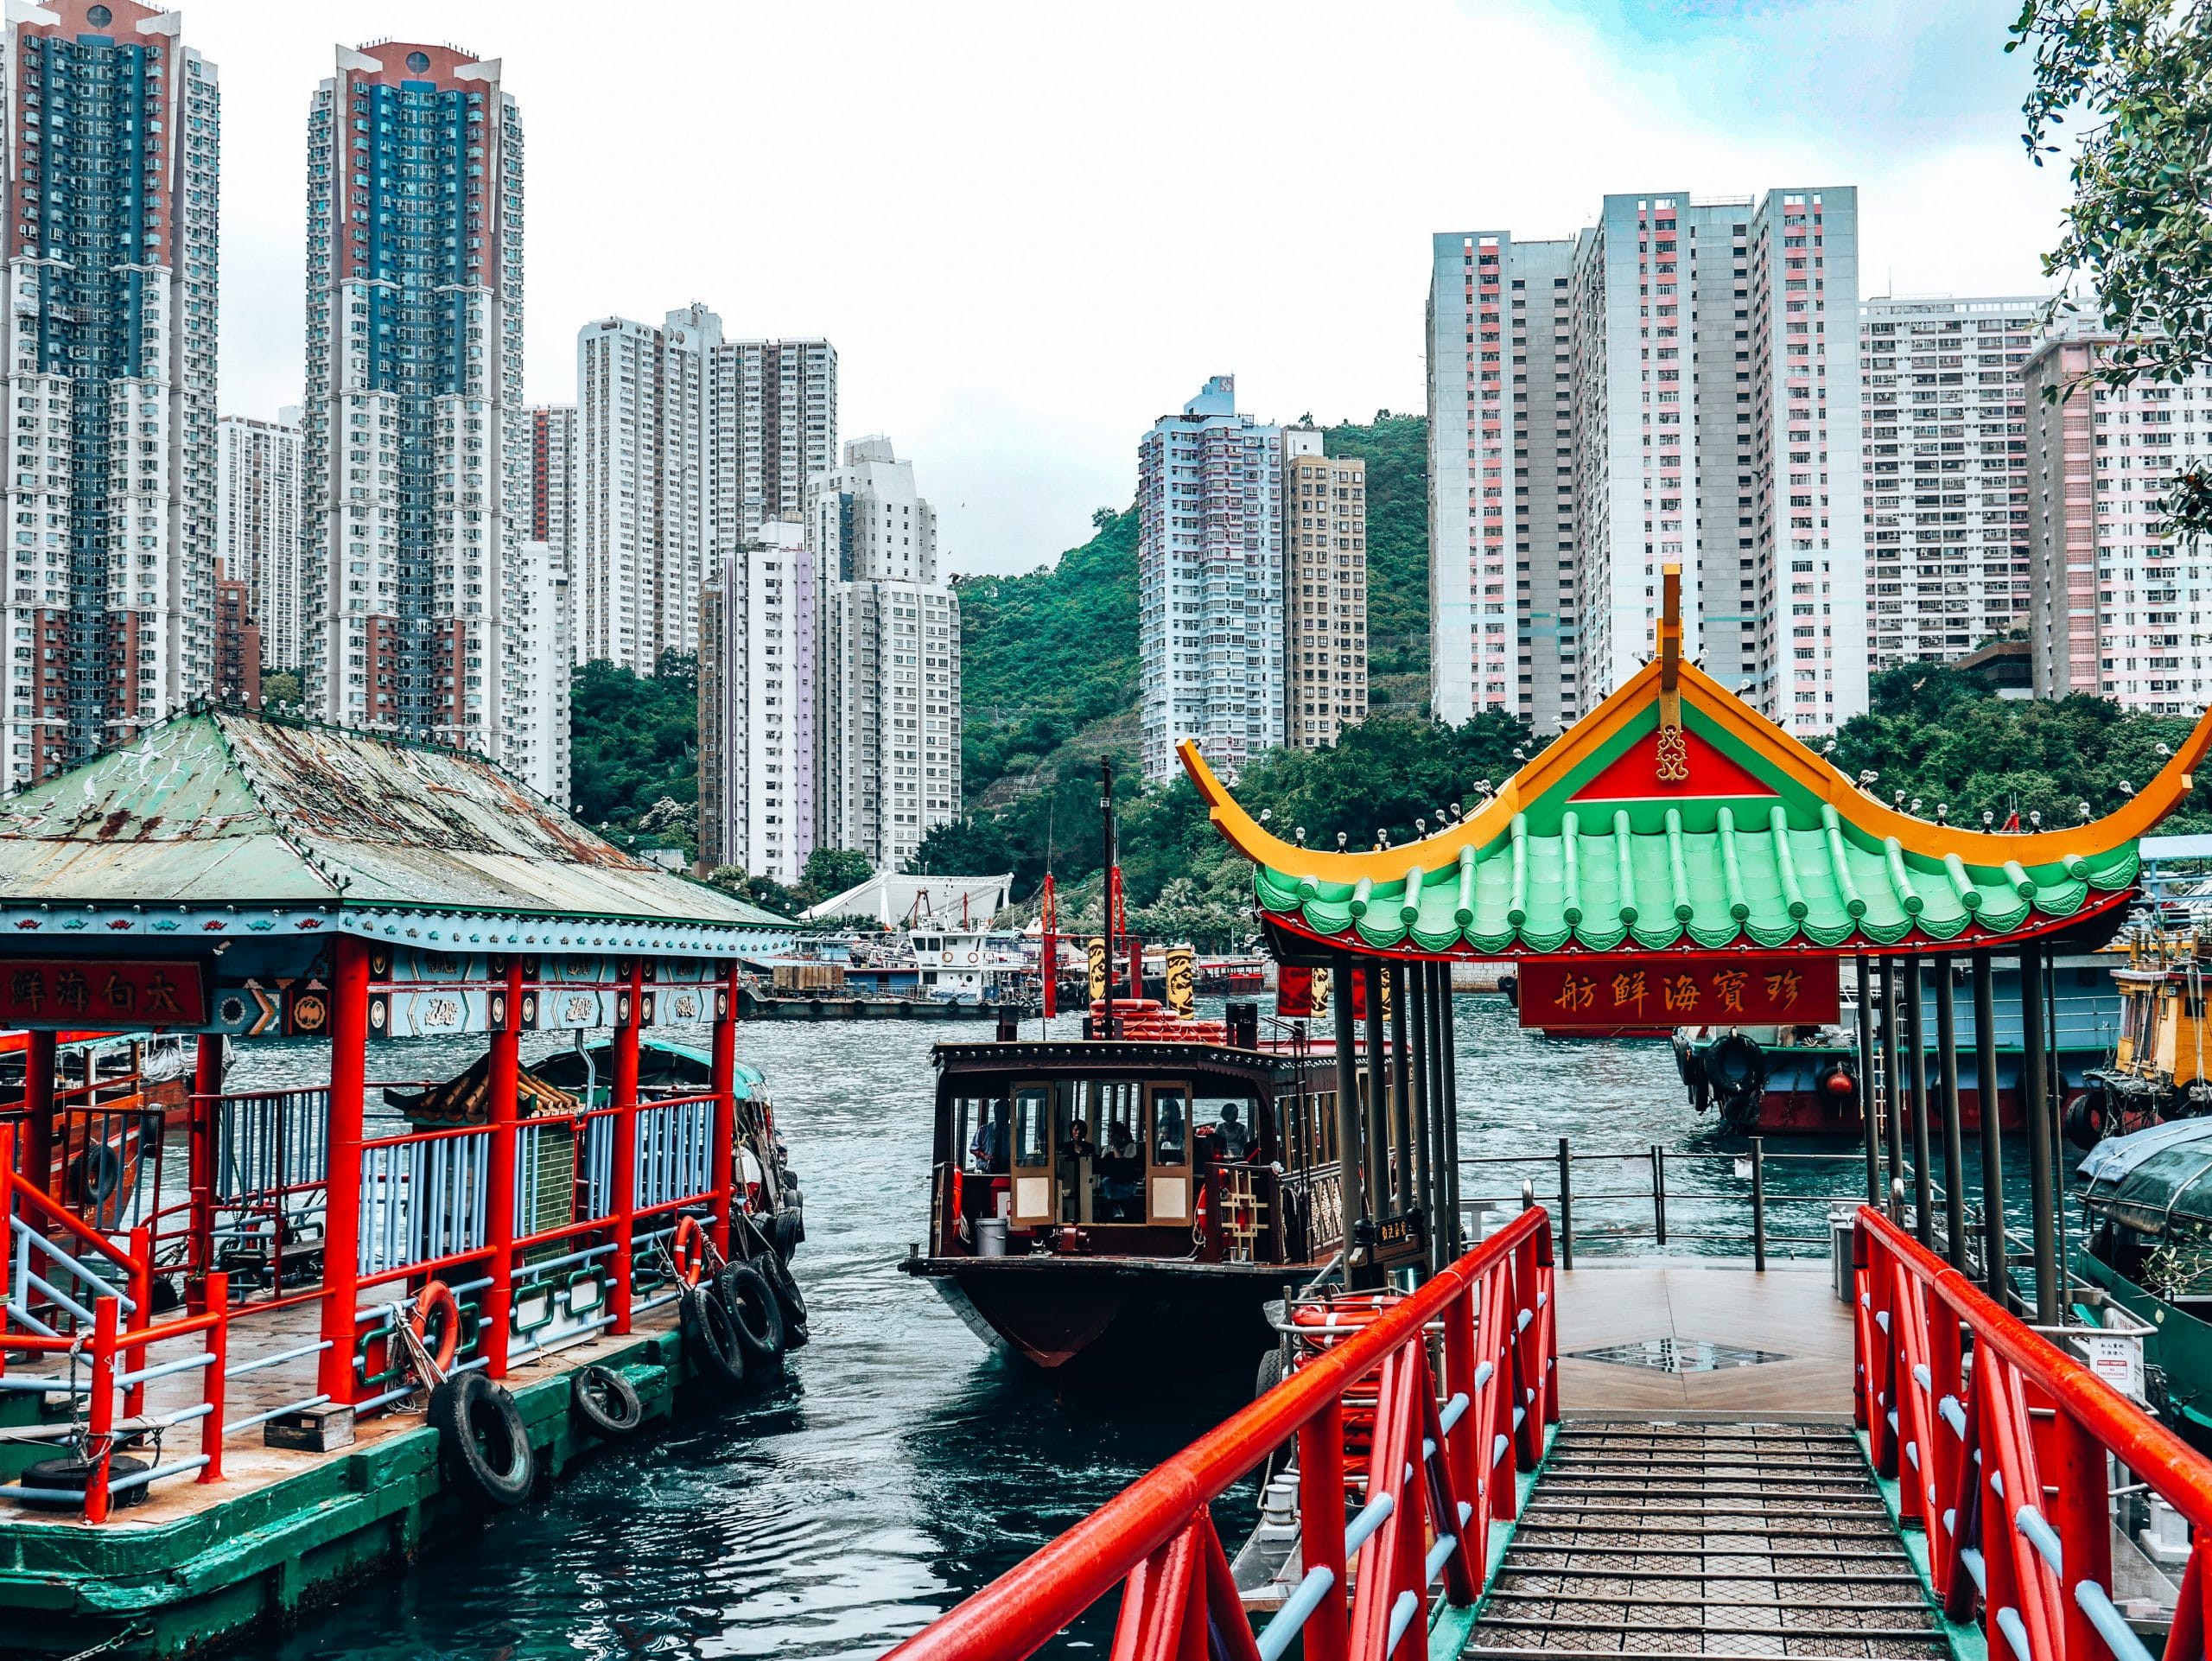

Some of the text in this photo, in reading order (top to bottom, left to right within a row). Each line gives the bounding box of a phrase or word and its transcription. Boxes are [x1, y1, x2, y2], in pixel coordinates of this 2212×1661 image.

[1554, 970, 1803, 1019] 珍寶海鮮舫
